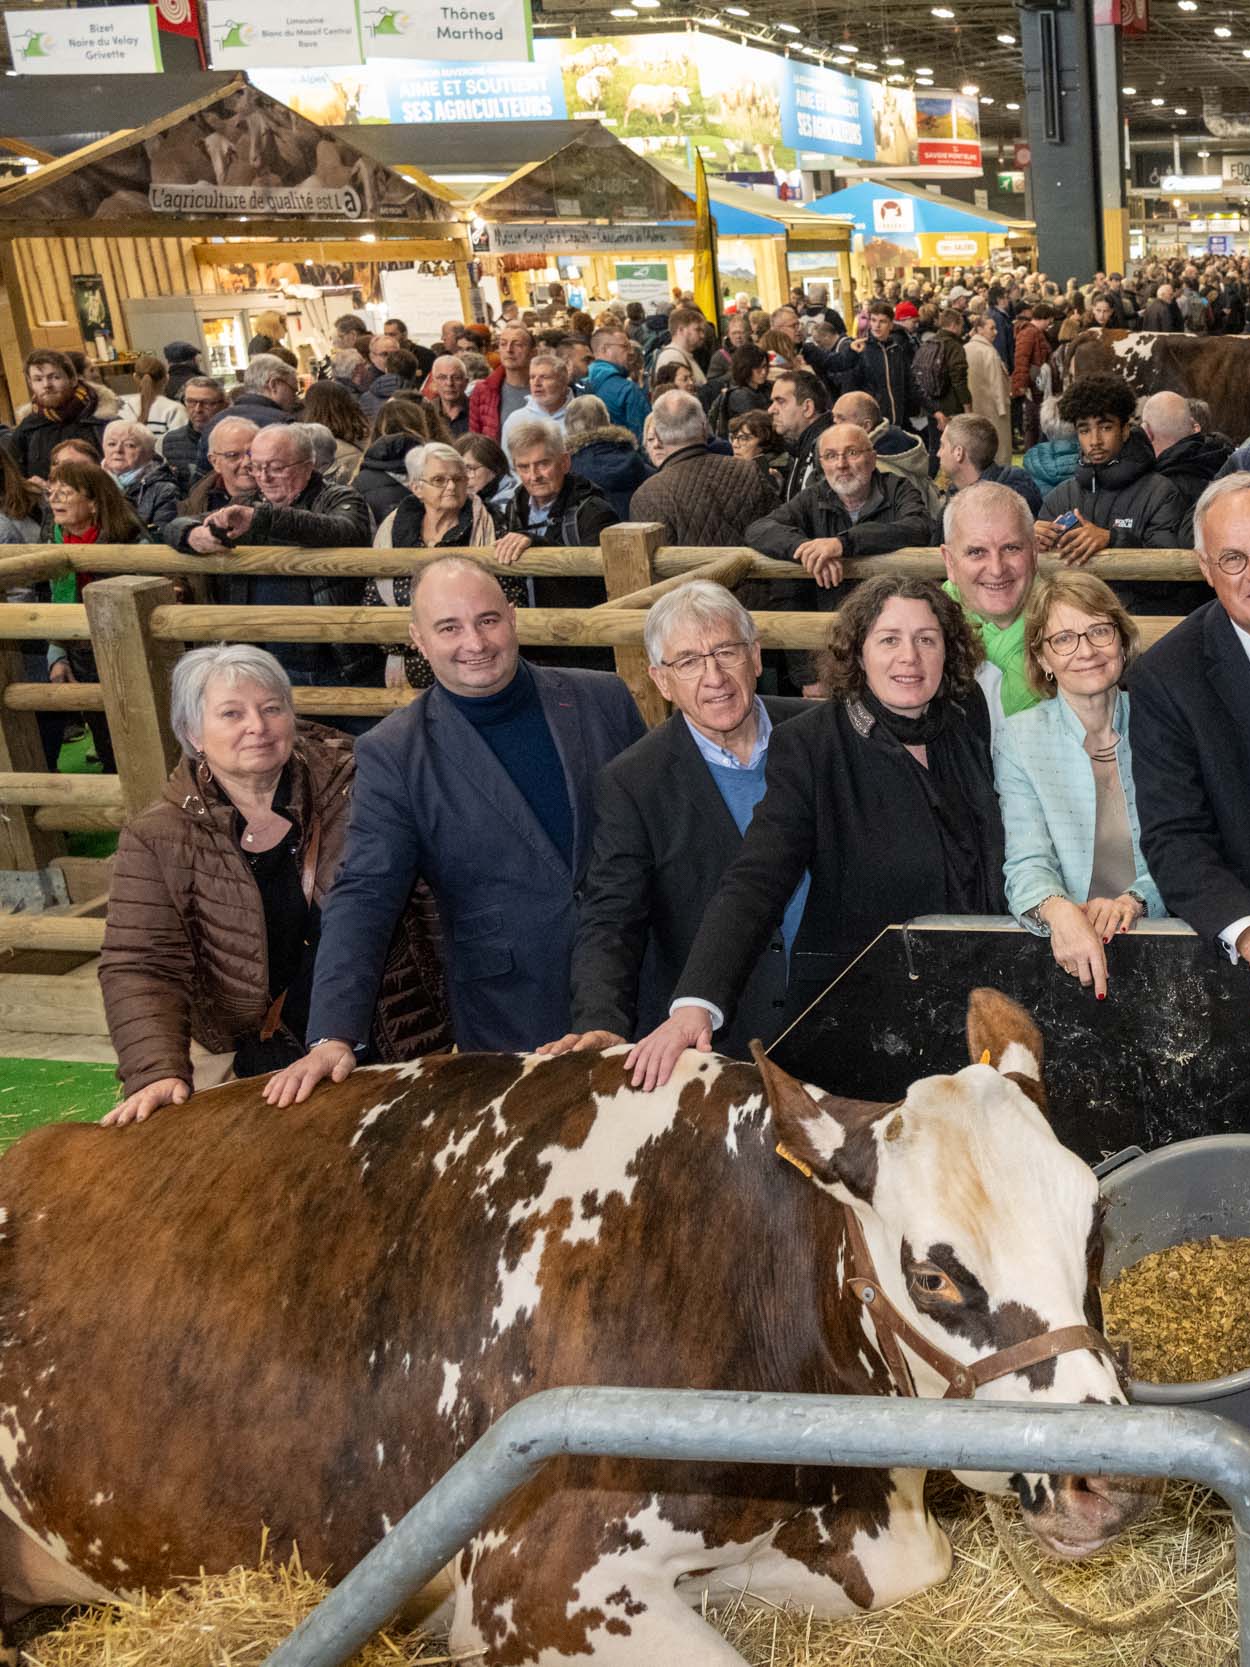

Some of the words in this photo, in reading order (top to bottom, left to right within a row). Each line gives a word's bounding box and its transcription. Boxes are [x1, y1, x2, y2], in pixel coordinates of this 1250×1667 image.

[440, 7, 496, 21] Thônes
[286, 17, 324, 25] Limousine
[90, 24, 114, 33] Bizet
[296, 28, 322, 36] Massif
[324, 26, 353, 35] Central
[437, 27, 503, 40] Marthod
[69, 39, 95, 47] Noire
[98, 38, 110, 46] du
[113, 36, 139, 47] Velay
[86, 51, 126, 60] Grivette
[402, 80, 441, 97] AIME
[443, 80, 462, 96] ET
[402, 101, 434, 124] SES
[434, 95, 553, 122] AGRICULTEURS
[151, 188, 246, 211] L'agriculture
[249, 190, 265, 209] de
[267, 189, 313, 212] qualité
[316, 194, 333, 209] est
